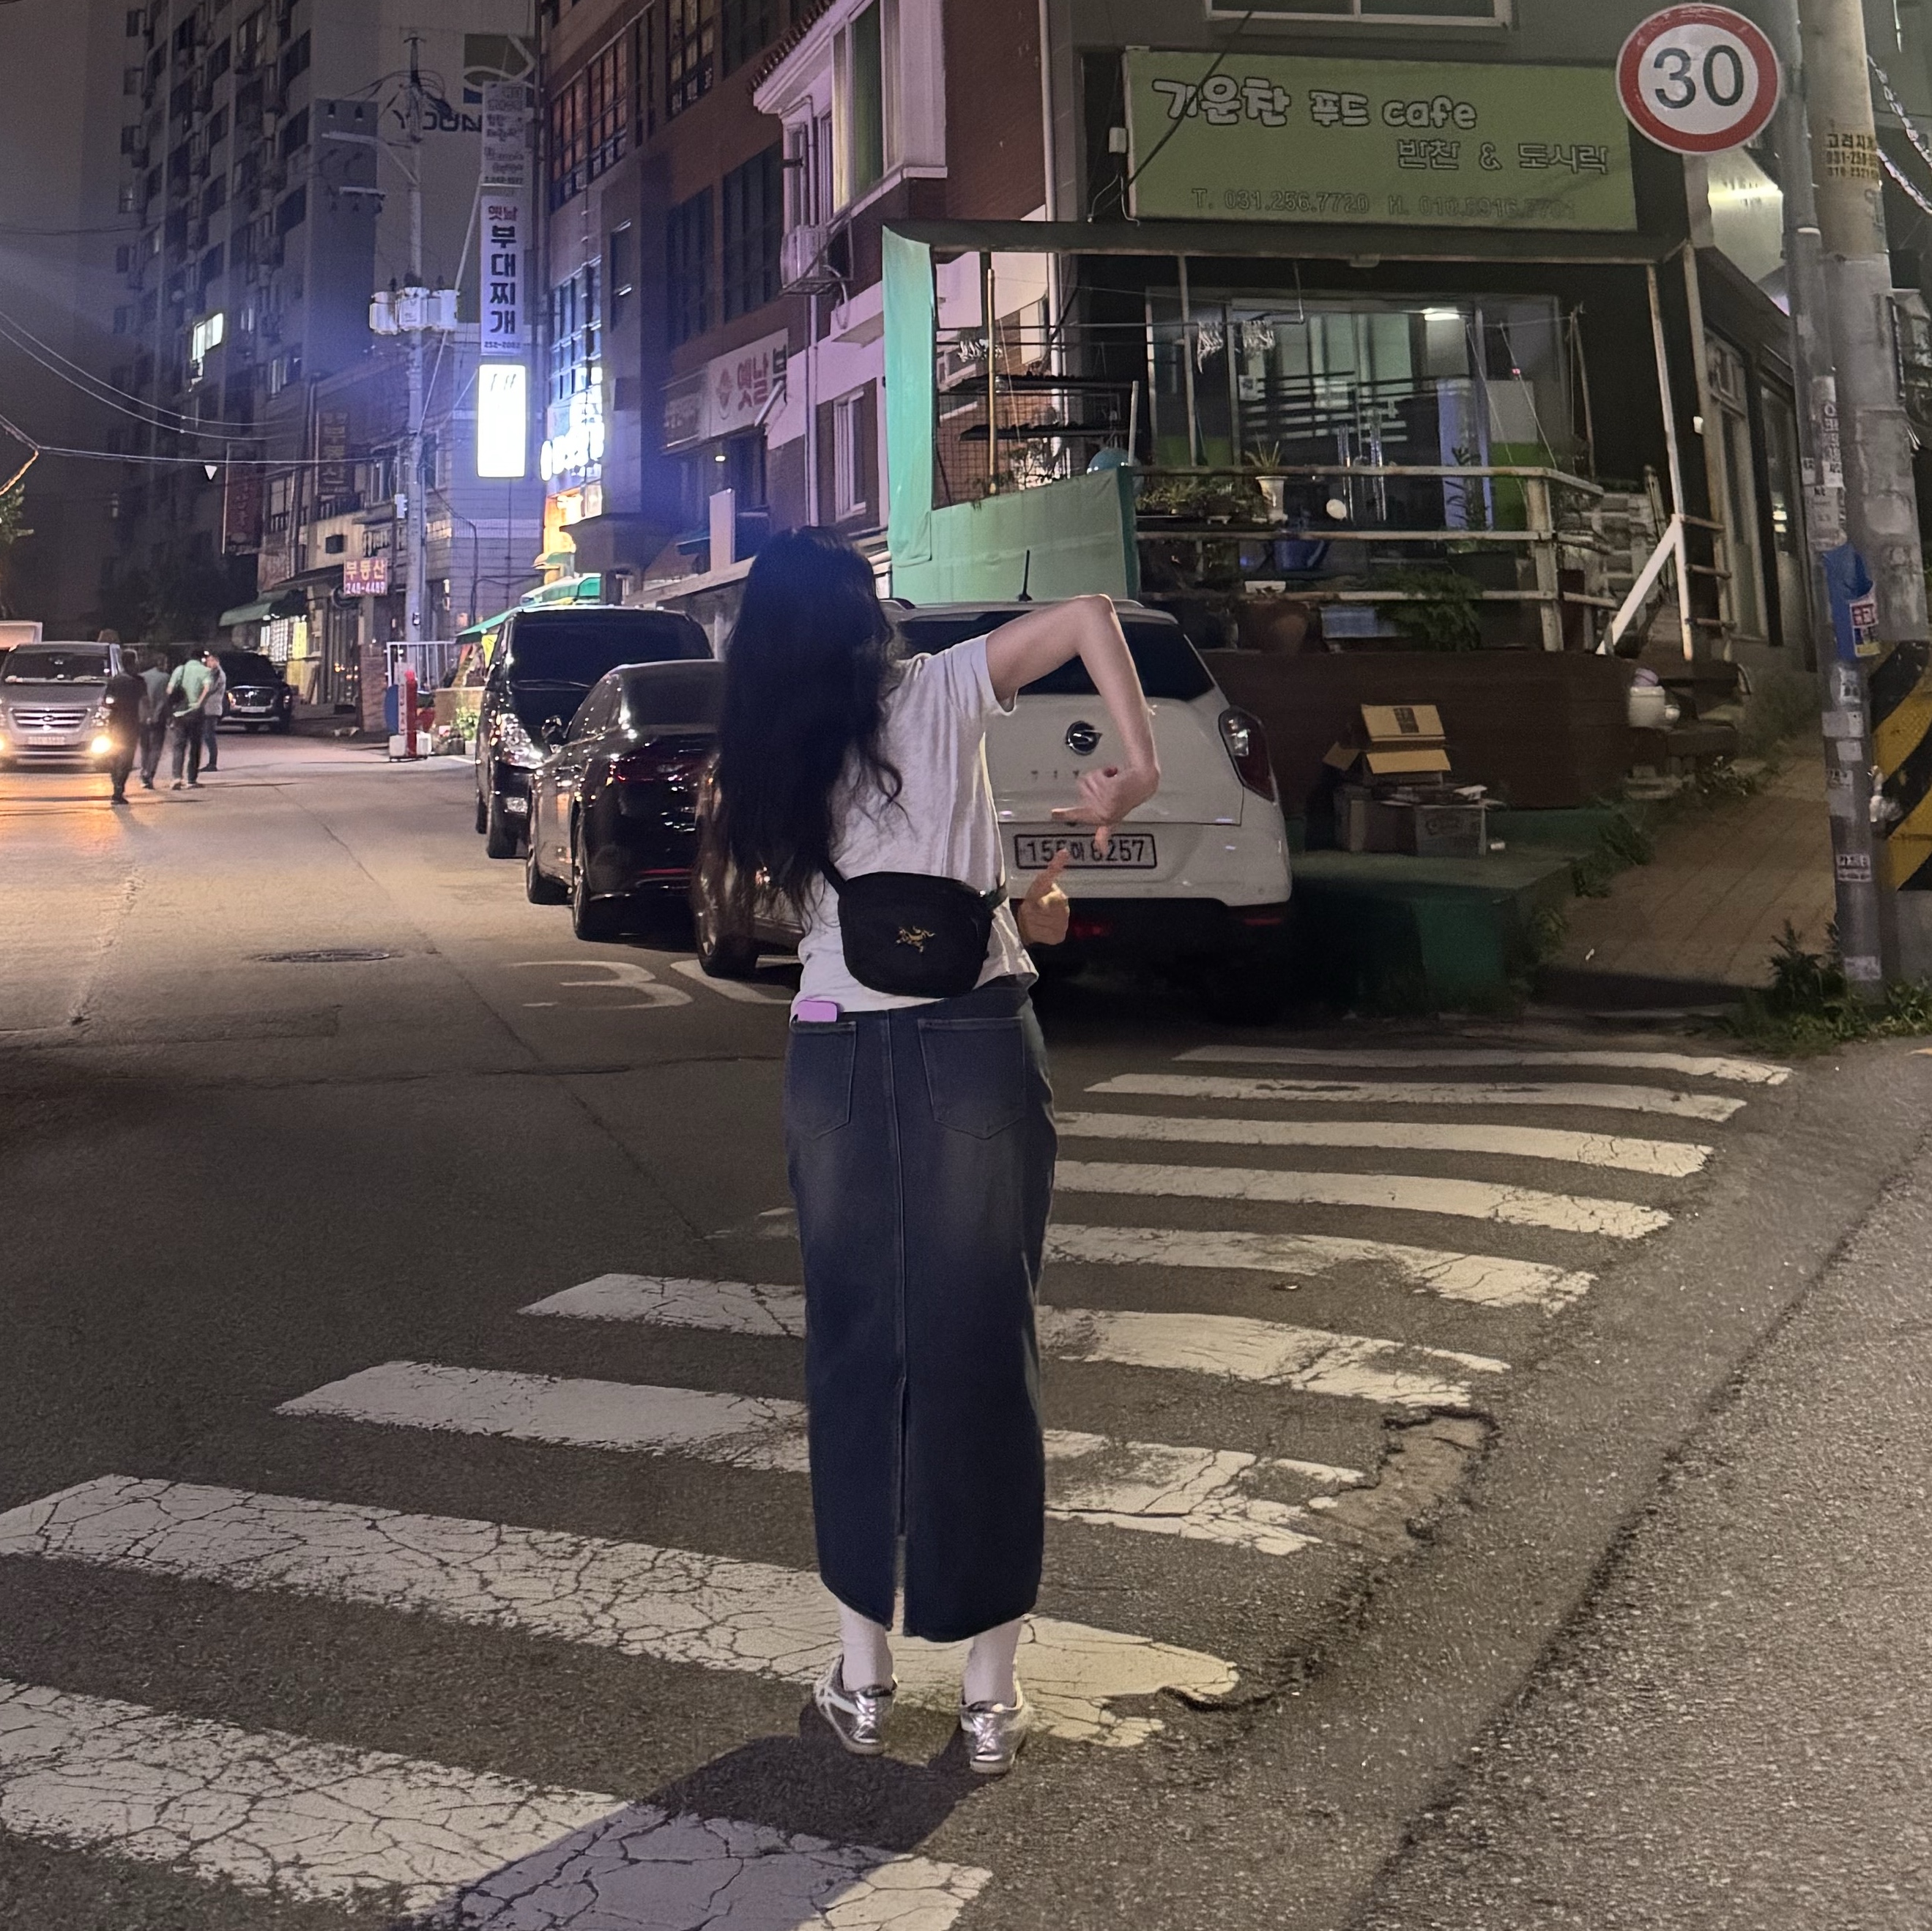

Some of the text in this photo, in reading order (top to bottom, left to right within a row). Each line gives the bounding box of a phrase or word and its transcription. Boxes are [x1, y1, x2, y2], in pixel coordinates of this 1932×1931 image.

[1152, 74, 1478, 130] 기운찬 푸드 cafe
[1653, 44, 1745, 109] 30
[1397, 138, 1608, 175] 반찬 & 도시락
[1192, 187, 1214, 209] T.
[489, 225, 517, 335] 부대찌개
